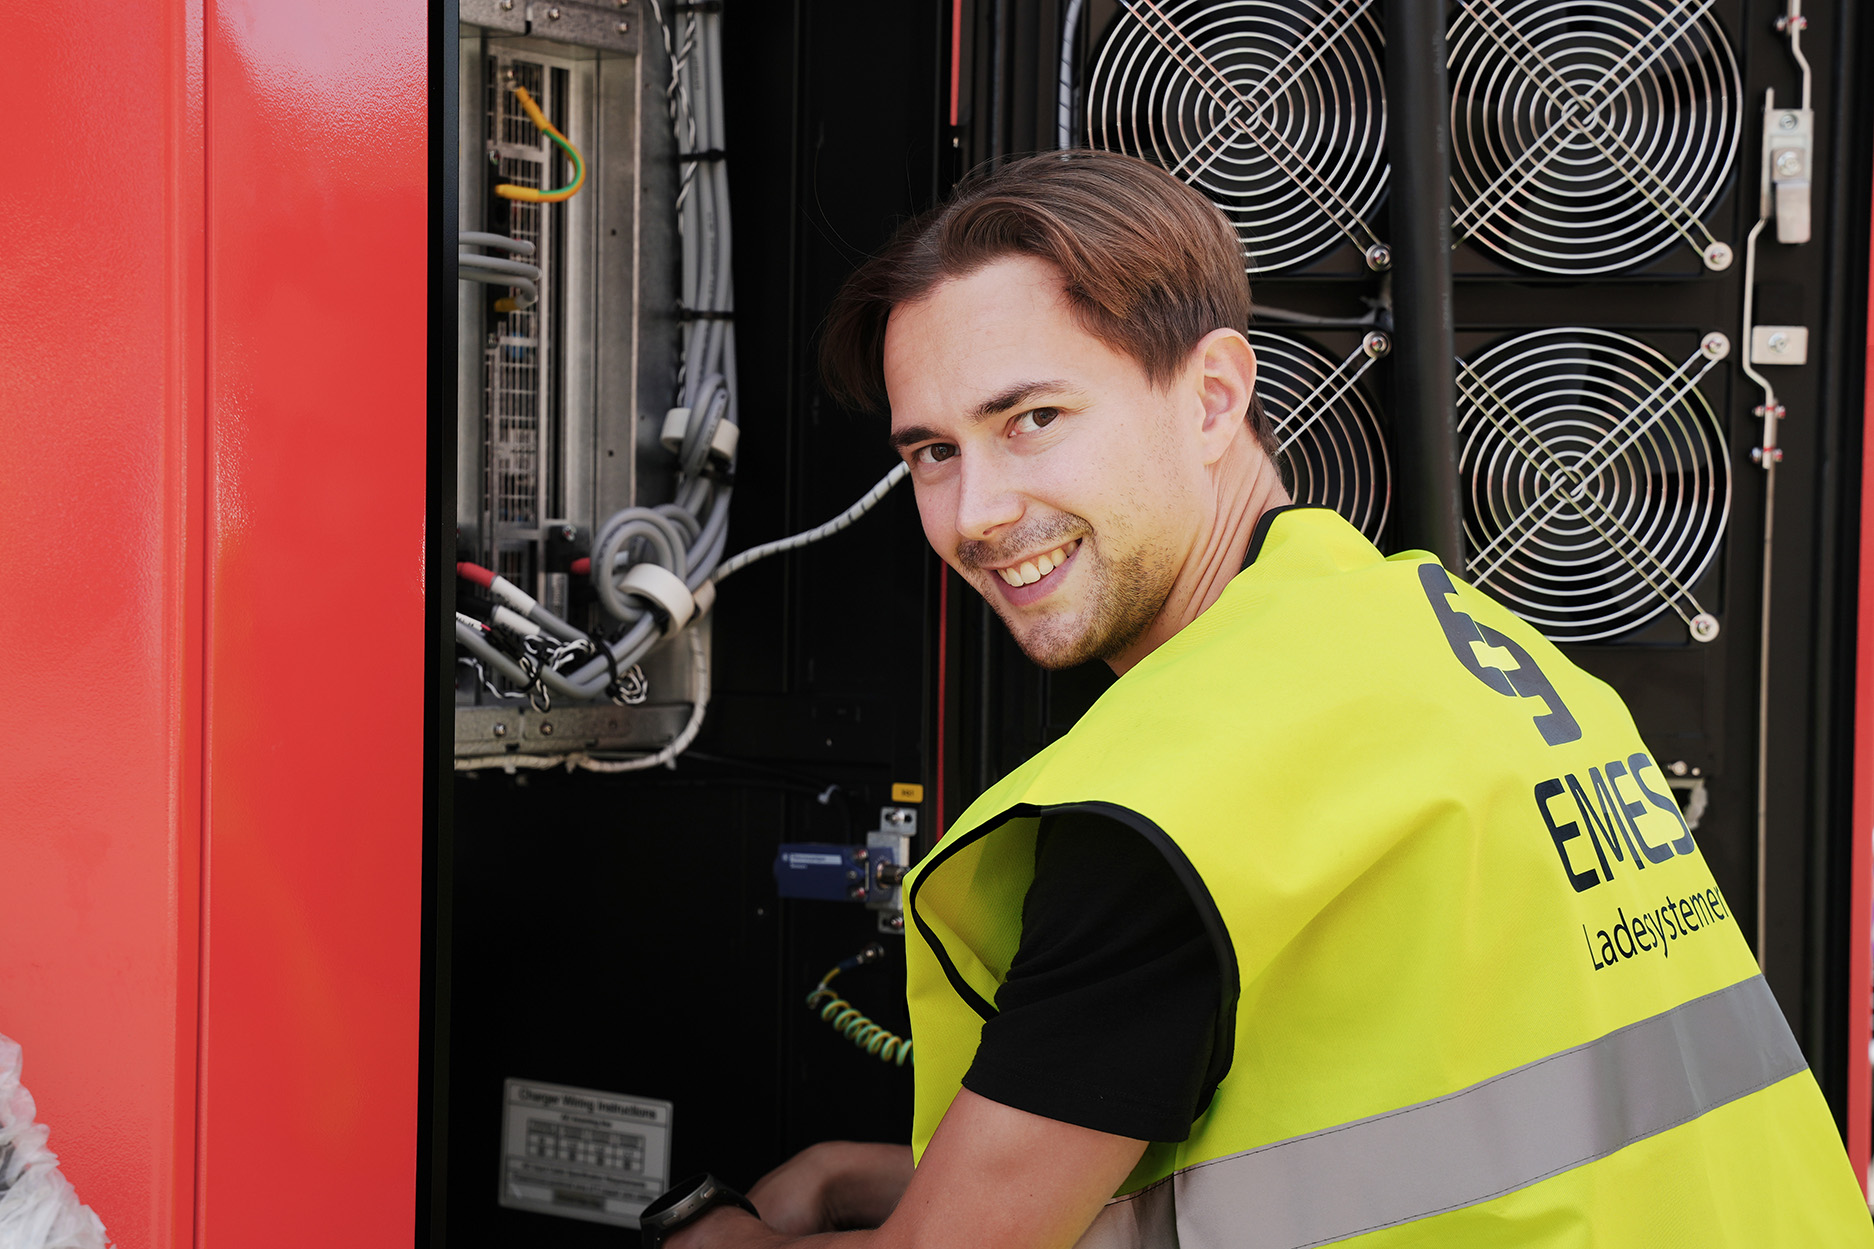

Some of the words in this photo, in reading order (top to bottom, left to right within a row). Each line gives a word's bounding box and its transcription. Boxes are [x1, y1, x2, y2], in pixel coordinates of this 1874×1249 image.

[1534, 753, 1695, 893] EMES
[1582, 886, 1730, 971] Ladesystemer
[520, 1087, 558, 1105] Charger
[562, 1094, 594, 1113] Wiring
[598, 1100, 657, 1119] Instructions
